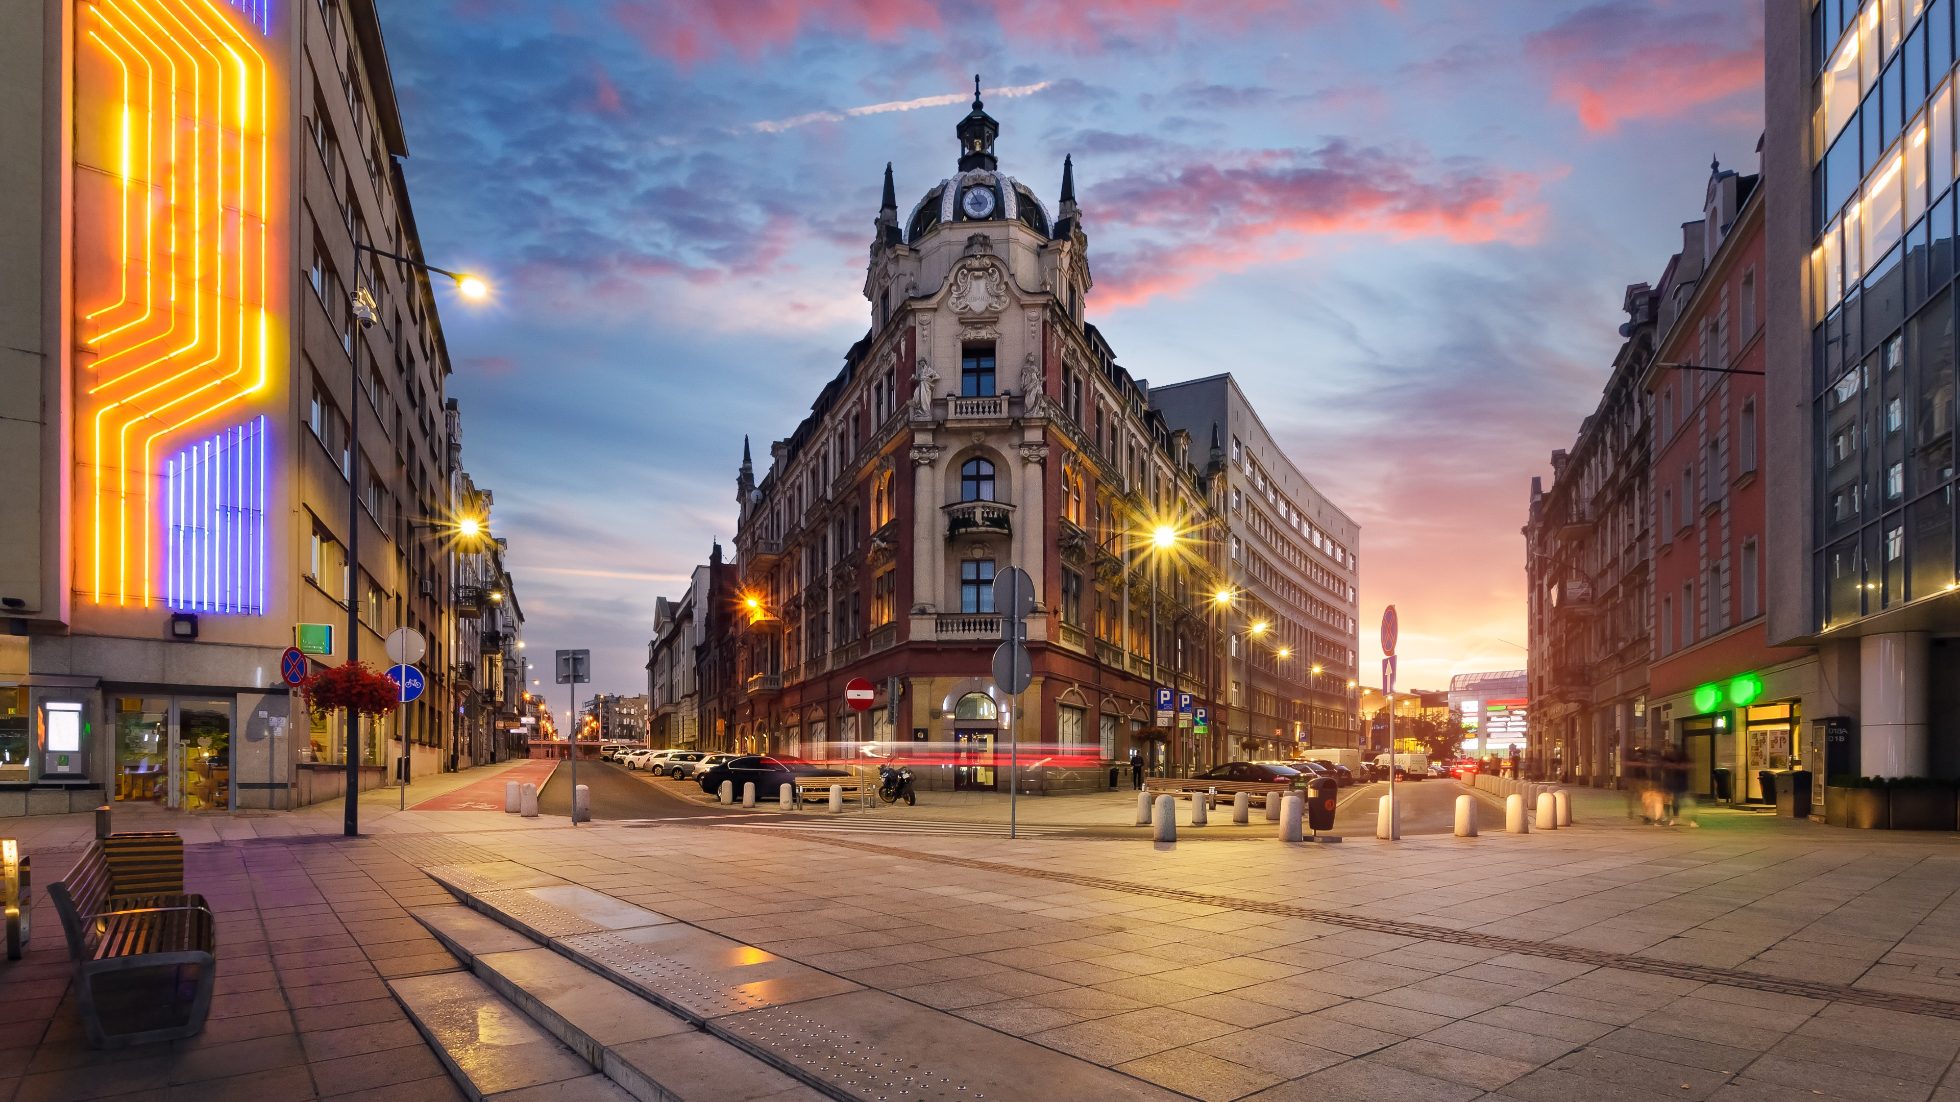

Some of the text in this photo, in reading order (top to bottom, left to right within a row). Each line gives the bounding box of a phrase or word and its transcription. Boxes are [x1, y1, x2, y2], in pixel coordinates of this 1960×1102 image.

[1160, 690, 1170, 704] P
[1182, 694, 1190, 707] P
[1197, 709, 1206, 720] P
